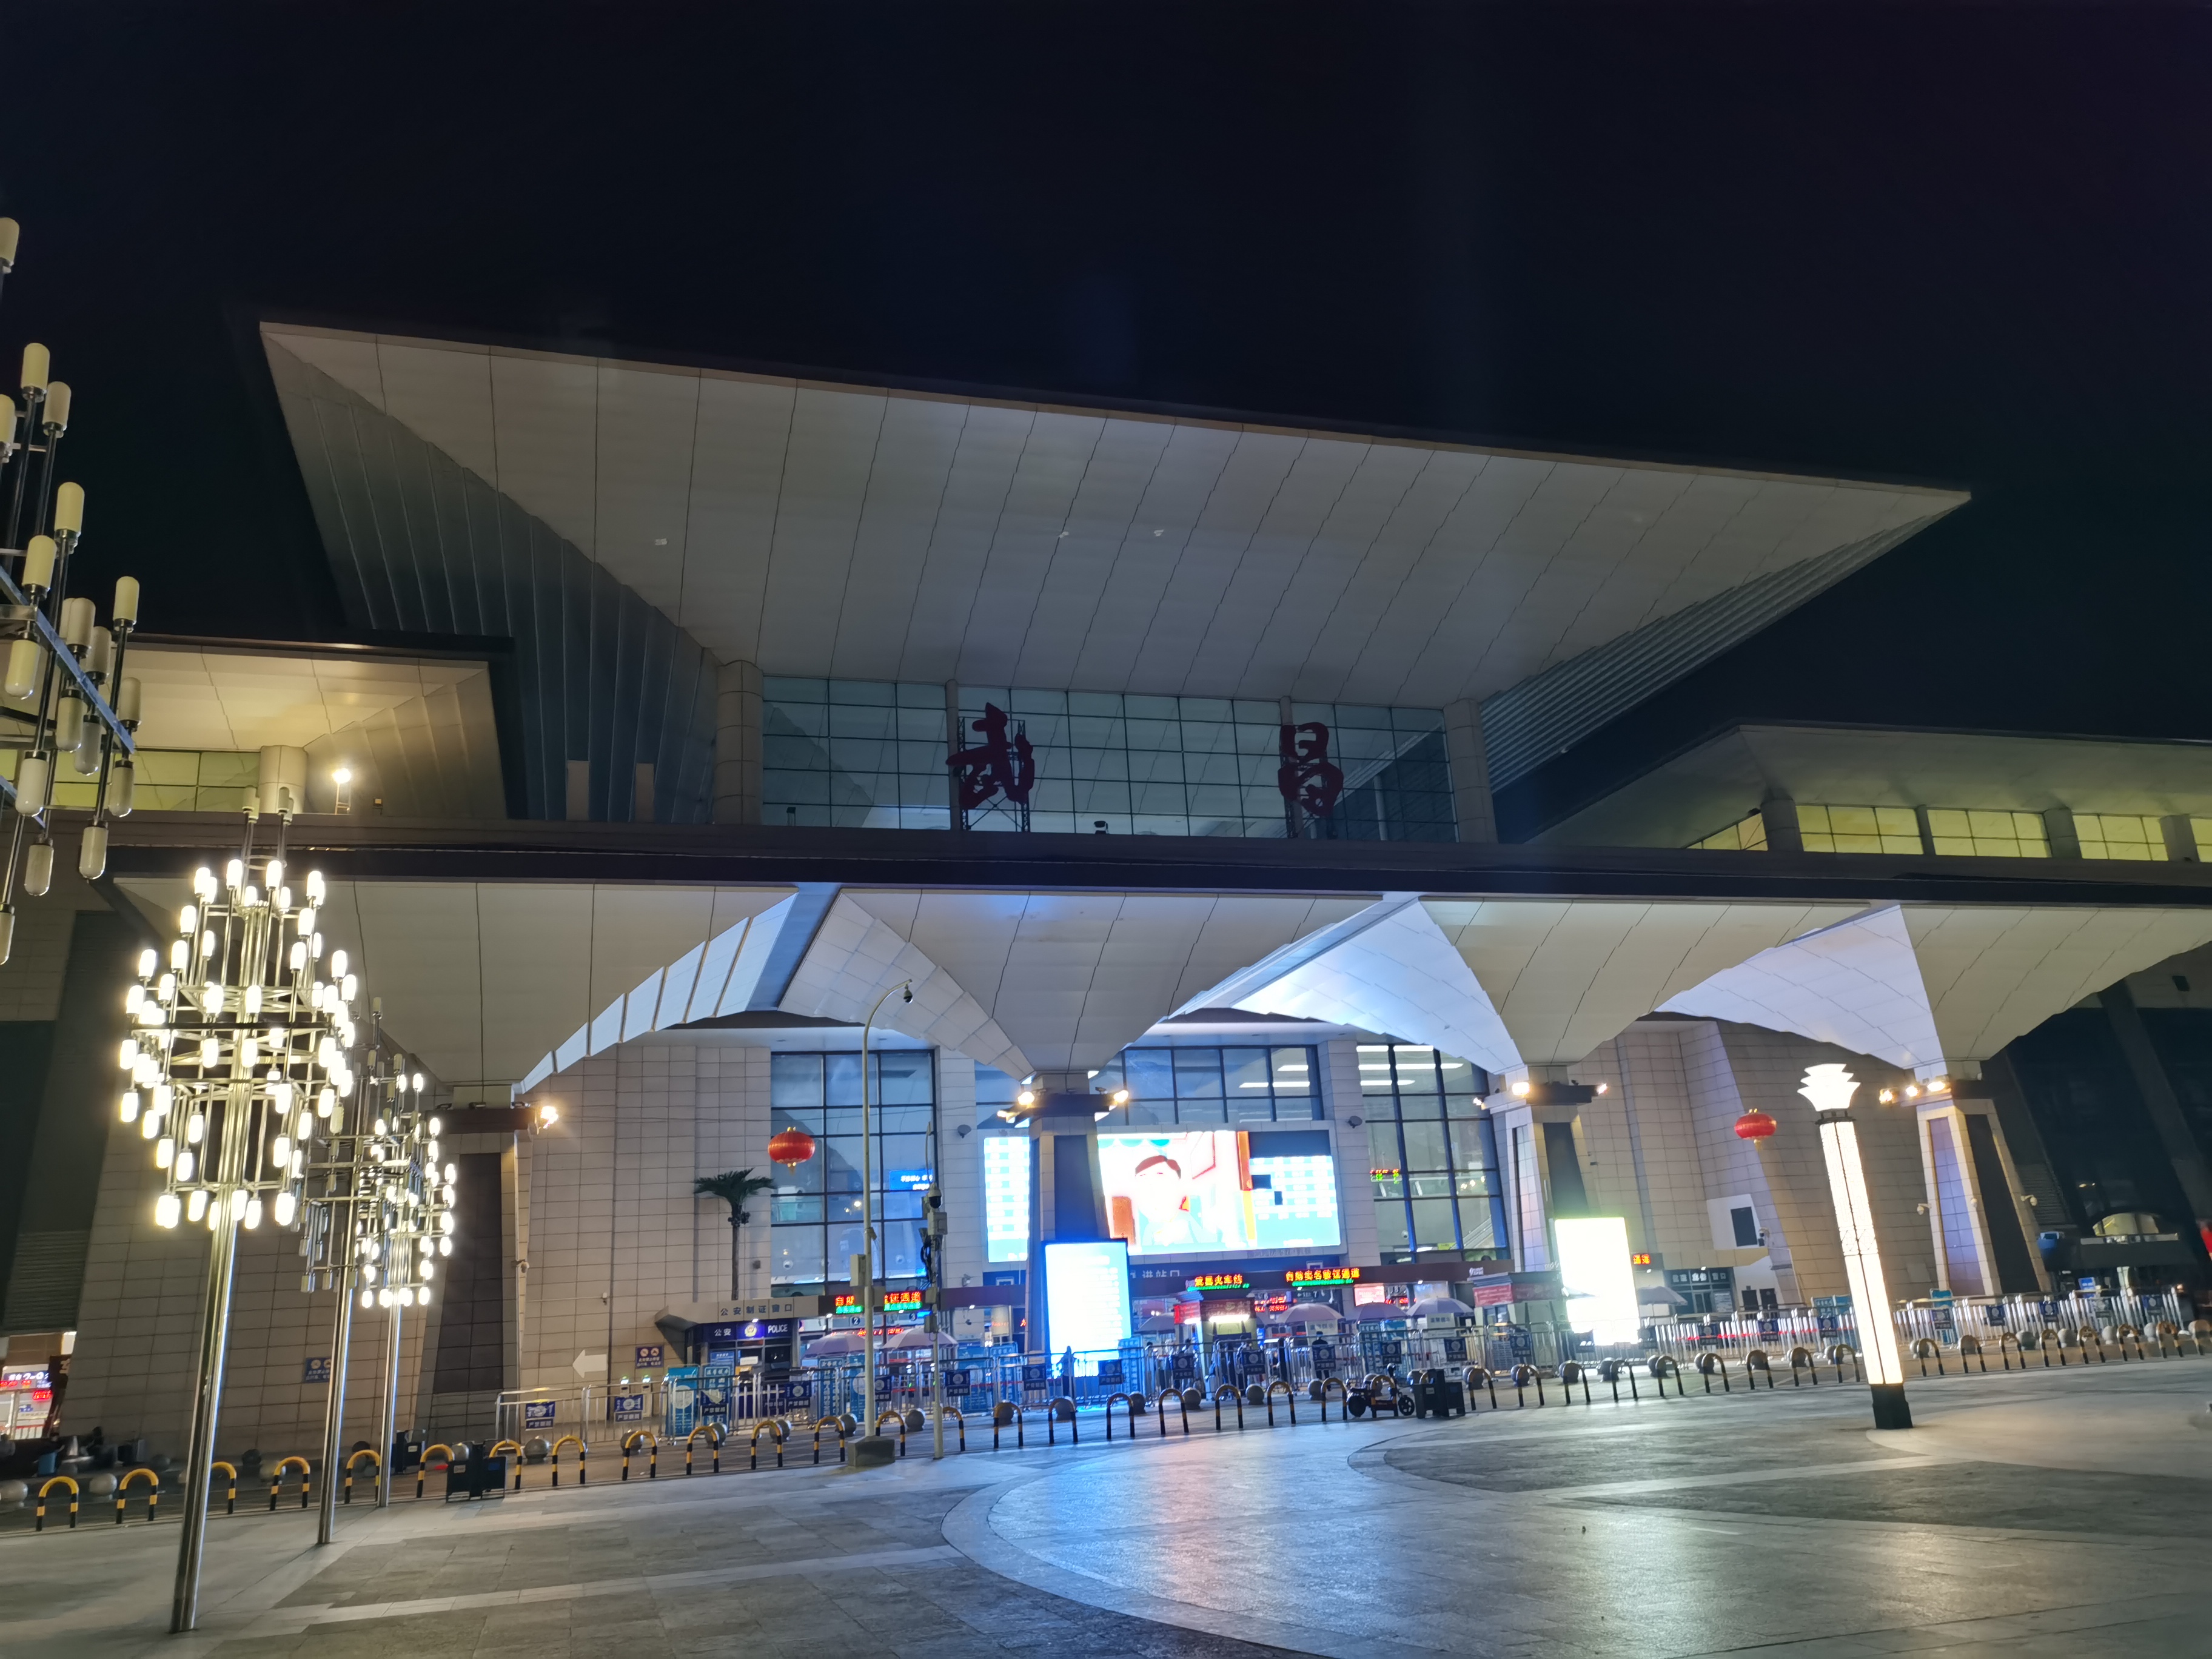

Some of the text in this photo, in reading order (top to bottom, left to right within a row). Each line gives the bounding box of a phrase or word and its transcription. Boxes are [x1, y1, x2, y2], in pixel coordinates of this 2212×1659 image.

[1194, 1273, 1243, 1287] 武昌火车站
[720, 1304, 793, 1316] 公安制证窗口
[853, 1317, 859, 1326] 2
[714, 1328, 732, 1336] 公安
[768, 1324, 788, 1334] POLICE
